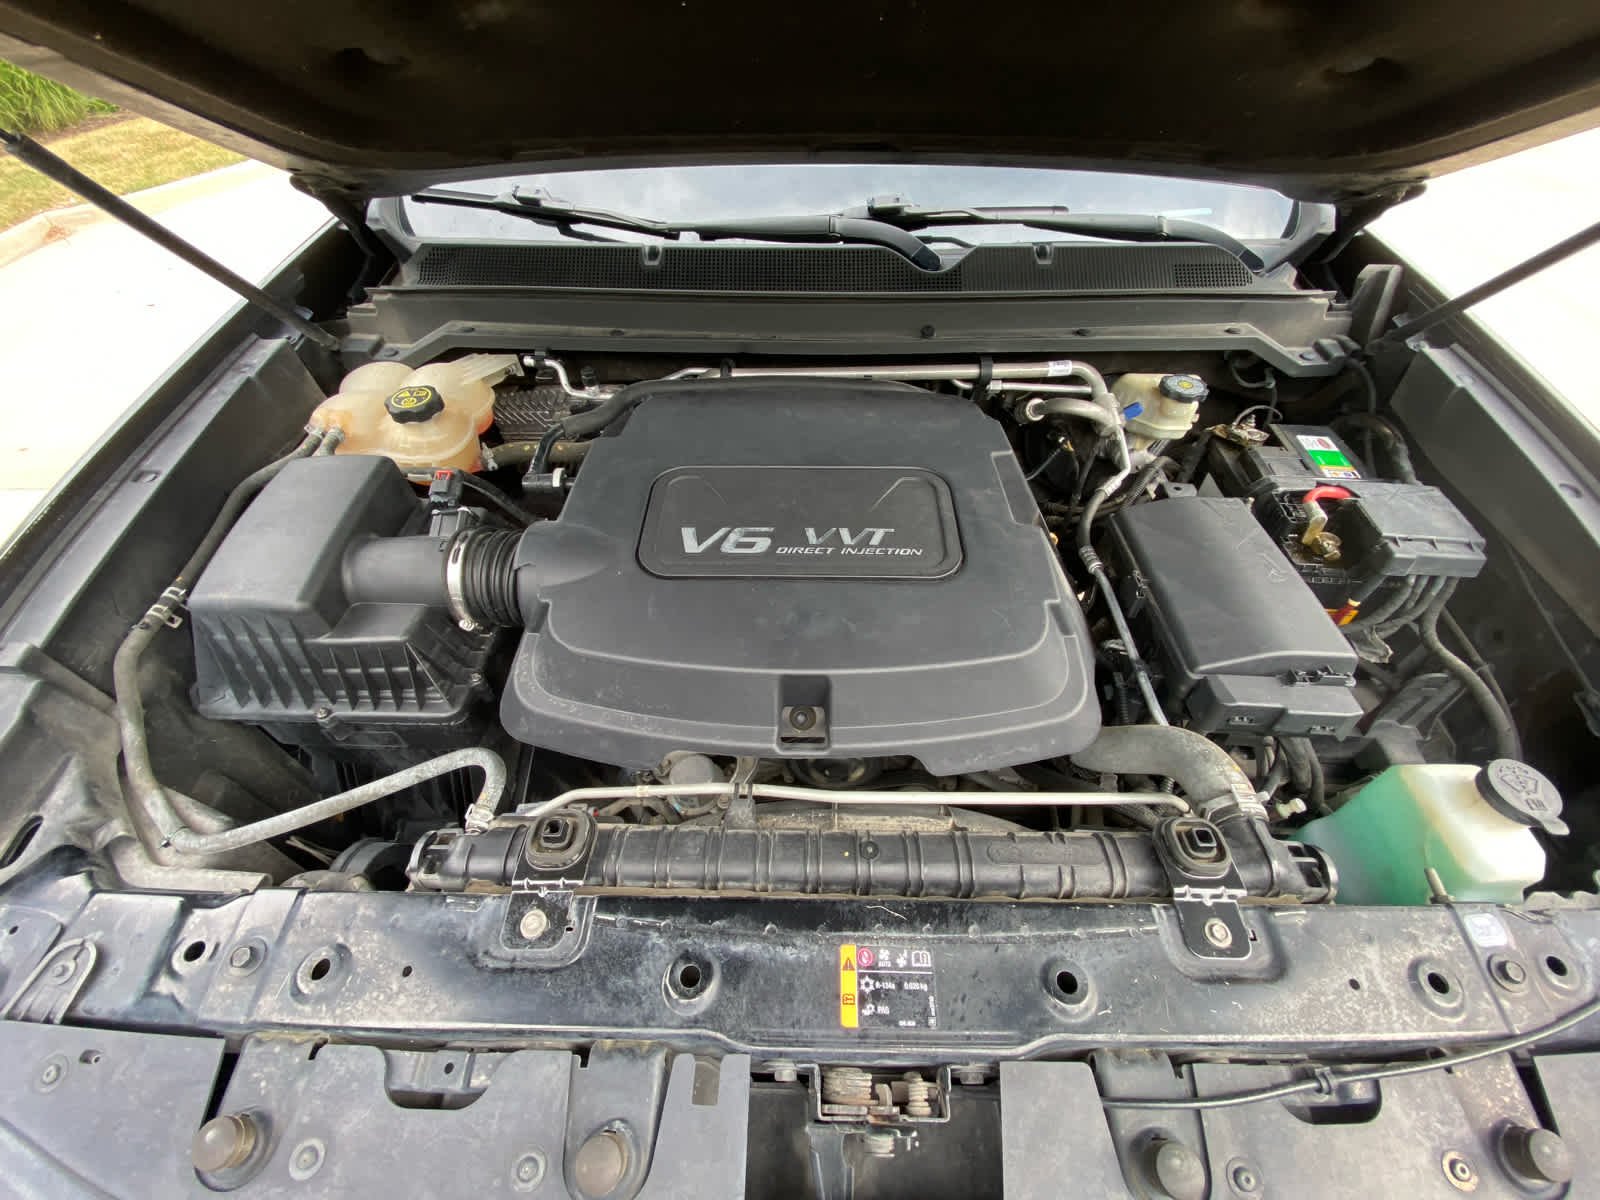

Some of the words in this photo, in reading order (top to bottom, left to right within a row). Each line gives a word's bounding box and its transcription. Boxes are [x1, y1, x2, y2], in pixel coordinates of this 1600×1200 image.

[681, 527, 775, 553] V6
[804, 527, 895, 545] VVT
[841, 547, 923, 556] INJECTION
